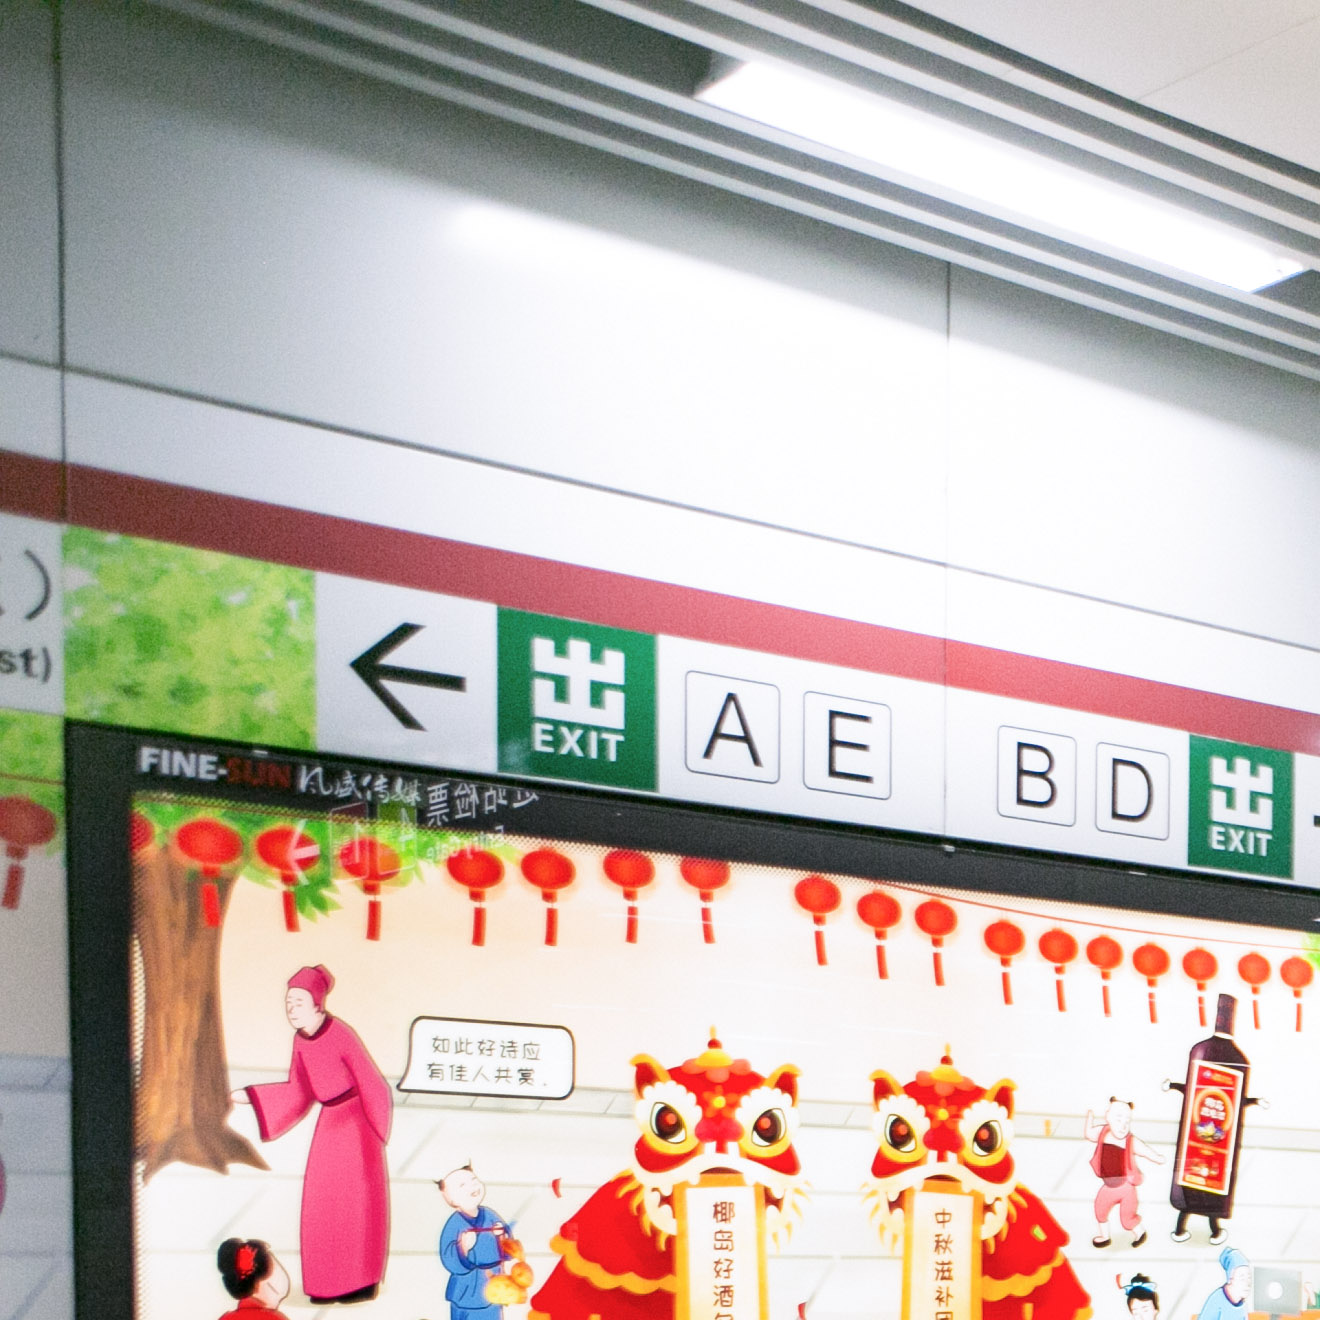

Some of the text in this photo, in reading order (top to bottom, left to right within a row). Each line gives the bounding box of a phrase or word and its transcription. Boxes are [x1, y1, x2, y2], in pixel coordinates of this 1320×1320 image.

[533, 722, 625, 763] EXIT
[702, 691, 764, 769] A
[827, 709, 873, 784] E
[140, 747, 291, 788] FINE-SUN
[1015, 742, 1058, 810] B
[1110, 758, 1153, 823] D
[1210, 825, 1273, 858] EXIT
[432, 1036, 541, 1060] 如此好诗应
